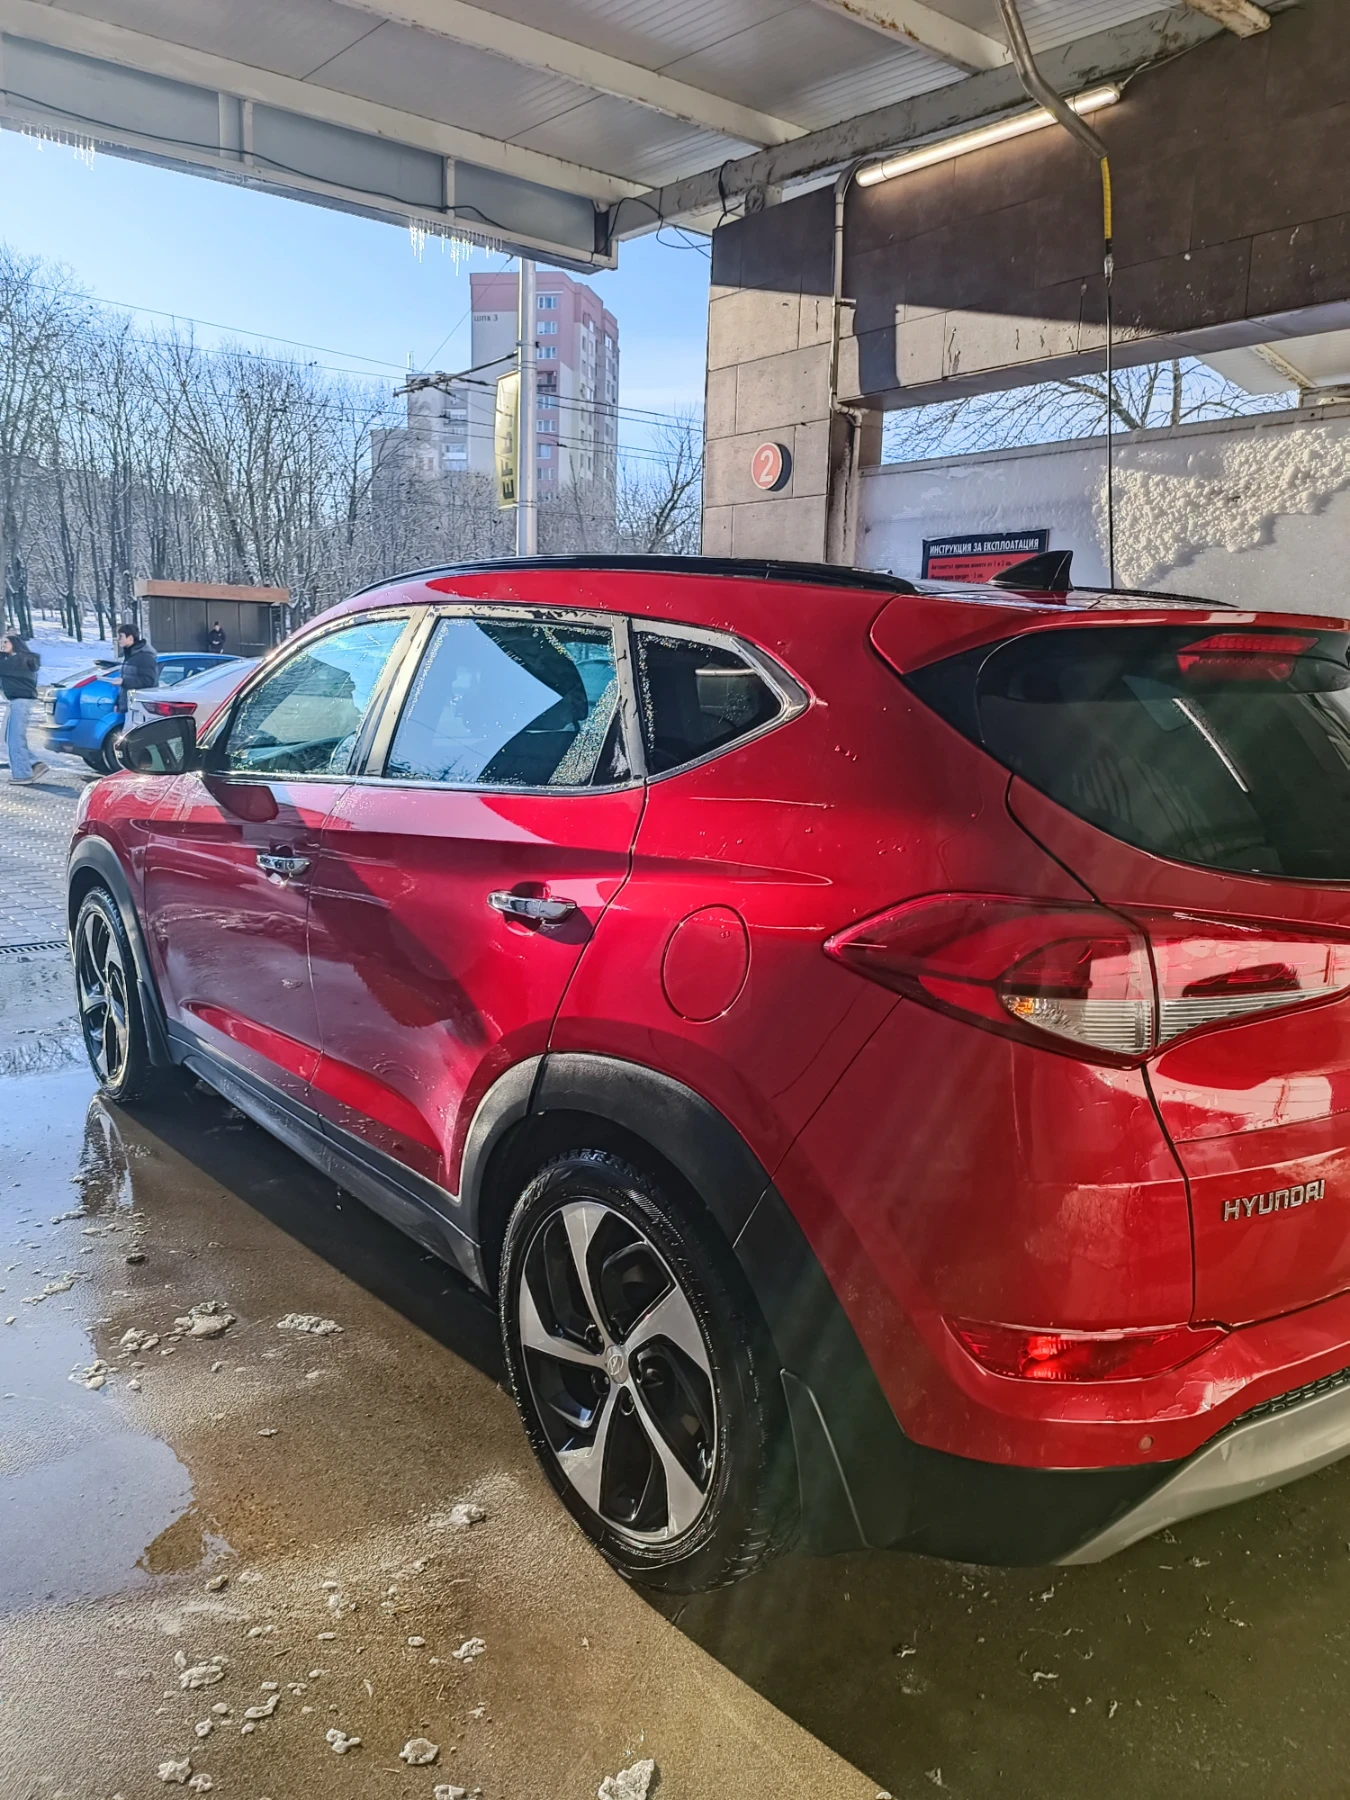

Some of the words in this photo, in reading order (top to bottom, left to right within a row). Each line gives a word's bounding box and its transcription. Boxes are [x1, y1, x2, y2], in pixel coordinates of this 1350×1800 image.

[759, 449, 774, 483] 2
[929, 543, 971, 555] ИНСТРУКЦИЯ
[973, 541, 982, 552] ЗА
[983, 538, 1039, 551] ЕКСПЛОАТАЦИЯ
[1223, 1179, 1325, 1222] HYUNDAI
